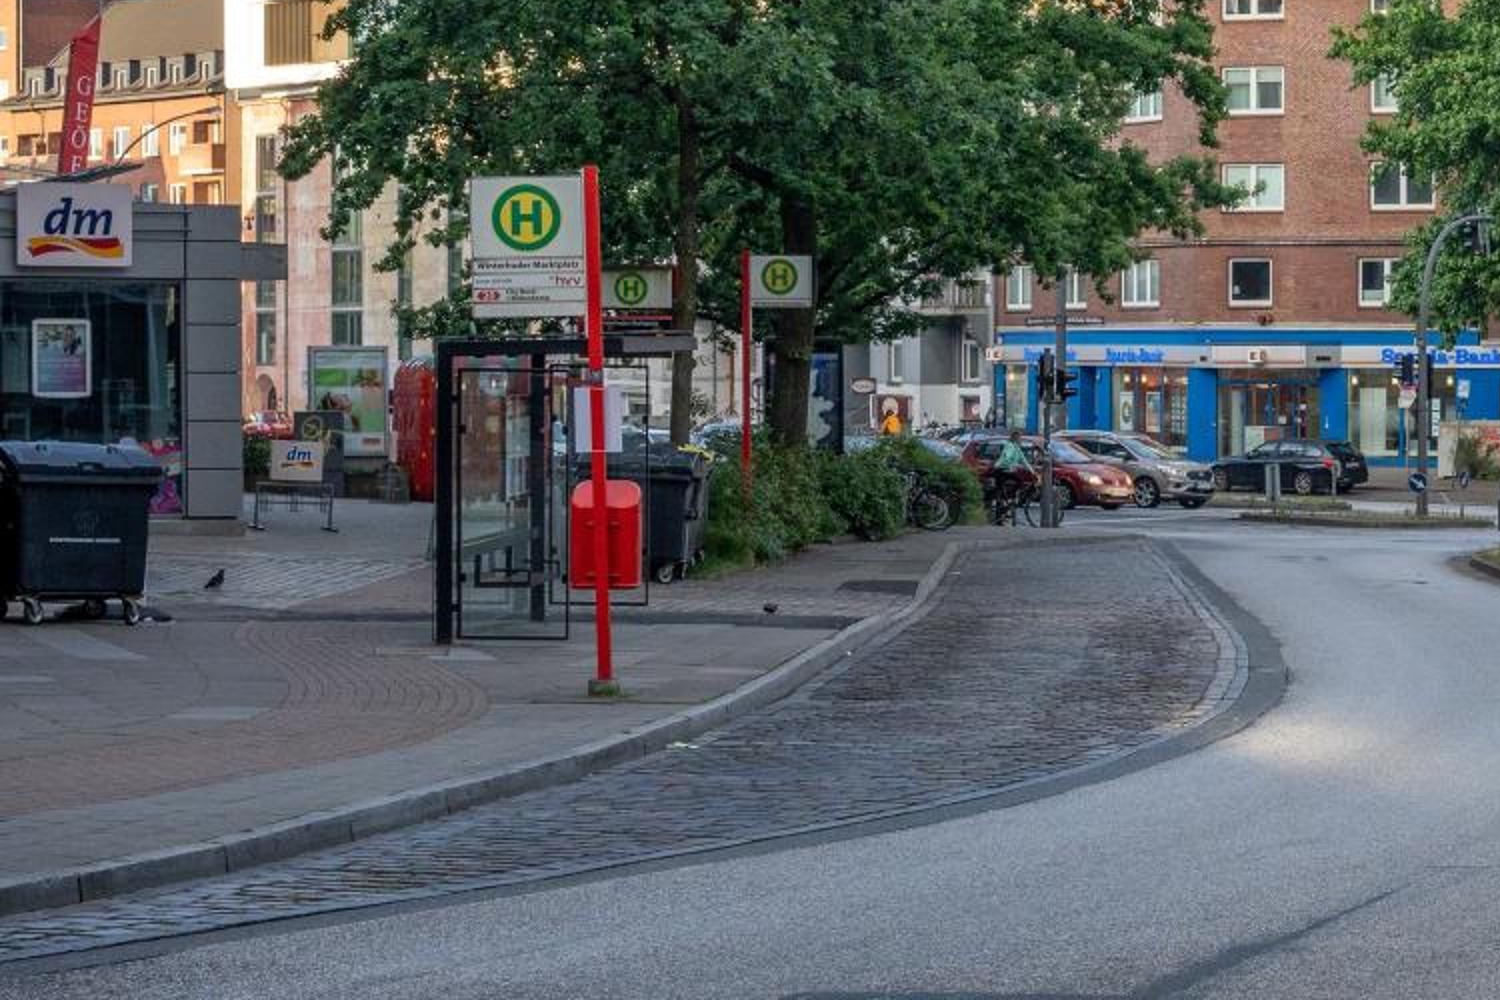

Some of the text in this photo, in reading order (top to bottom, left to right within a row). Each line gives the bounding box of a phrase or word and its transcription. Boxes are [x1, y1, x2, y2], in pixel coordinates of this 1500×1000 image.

[43, 197, 113, 236] dm
[511, 199, 543, 236] H
[533, 260, 579, 270] Marktplatz
[772, 268, 788, 287] H
[622, 279, 639, 298] H
[287, 445, 312, 461] dm
